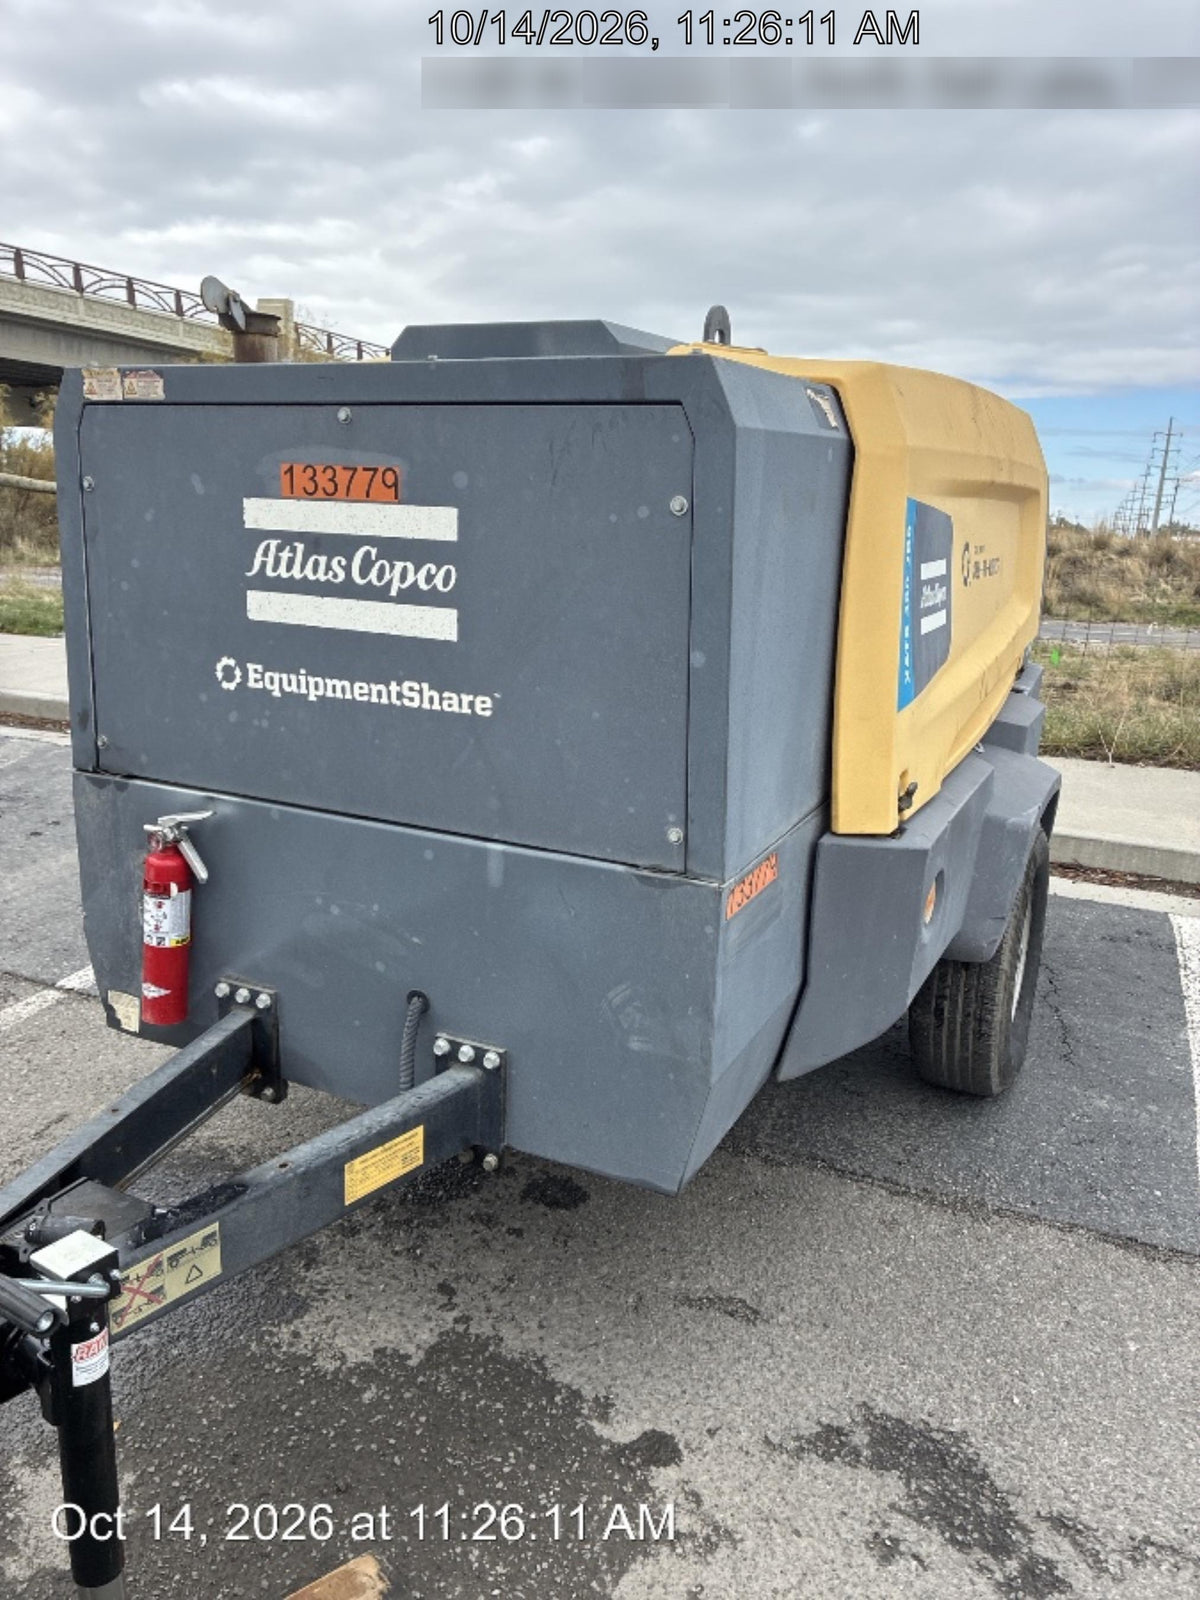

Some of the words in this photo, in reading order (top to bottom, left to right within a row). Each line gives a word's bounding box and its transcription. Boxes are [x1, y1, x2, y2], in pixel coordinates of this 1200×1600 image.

[282, 463, 399, 499] 133779
[245, 539, 347, 583] Atlas
[351, 544, 457, 596] Copco
[246, 662, 494, 717] EquipmentShare
